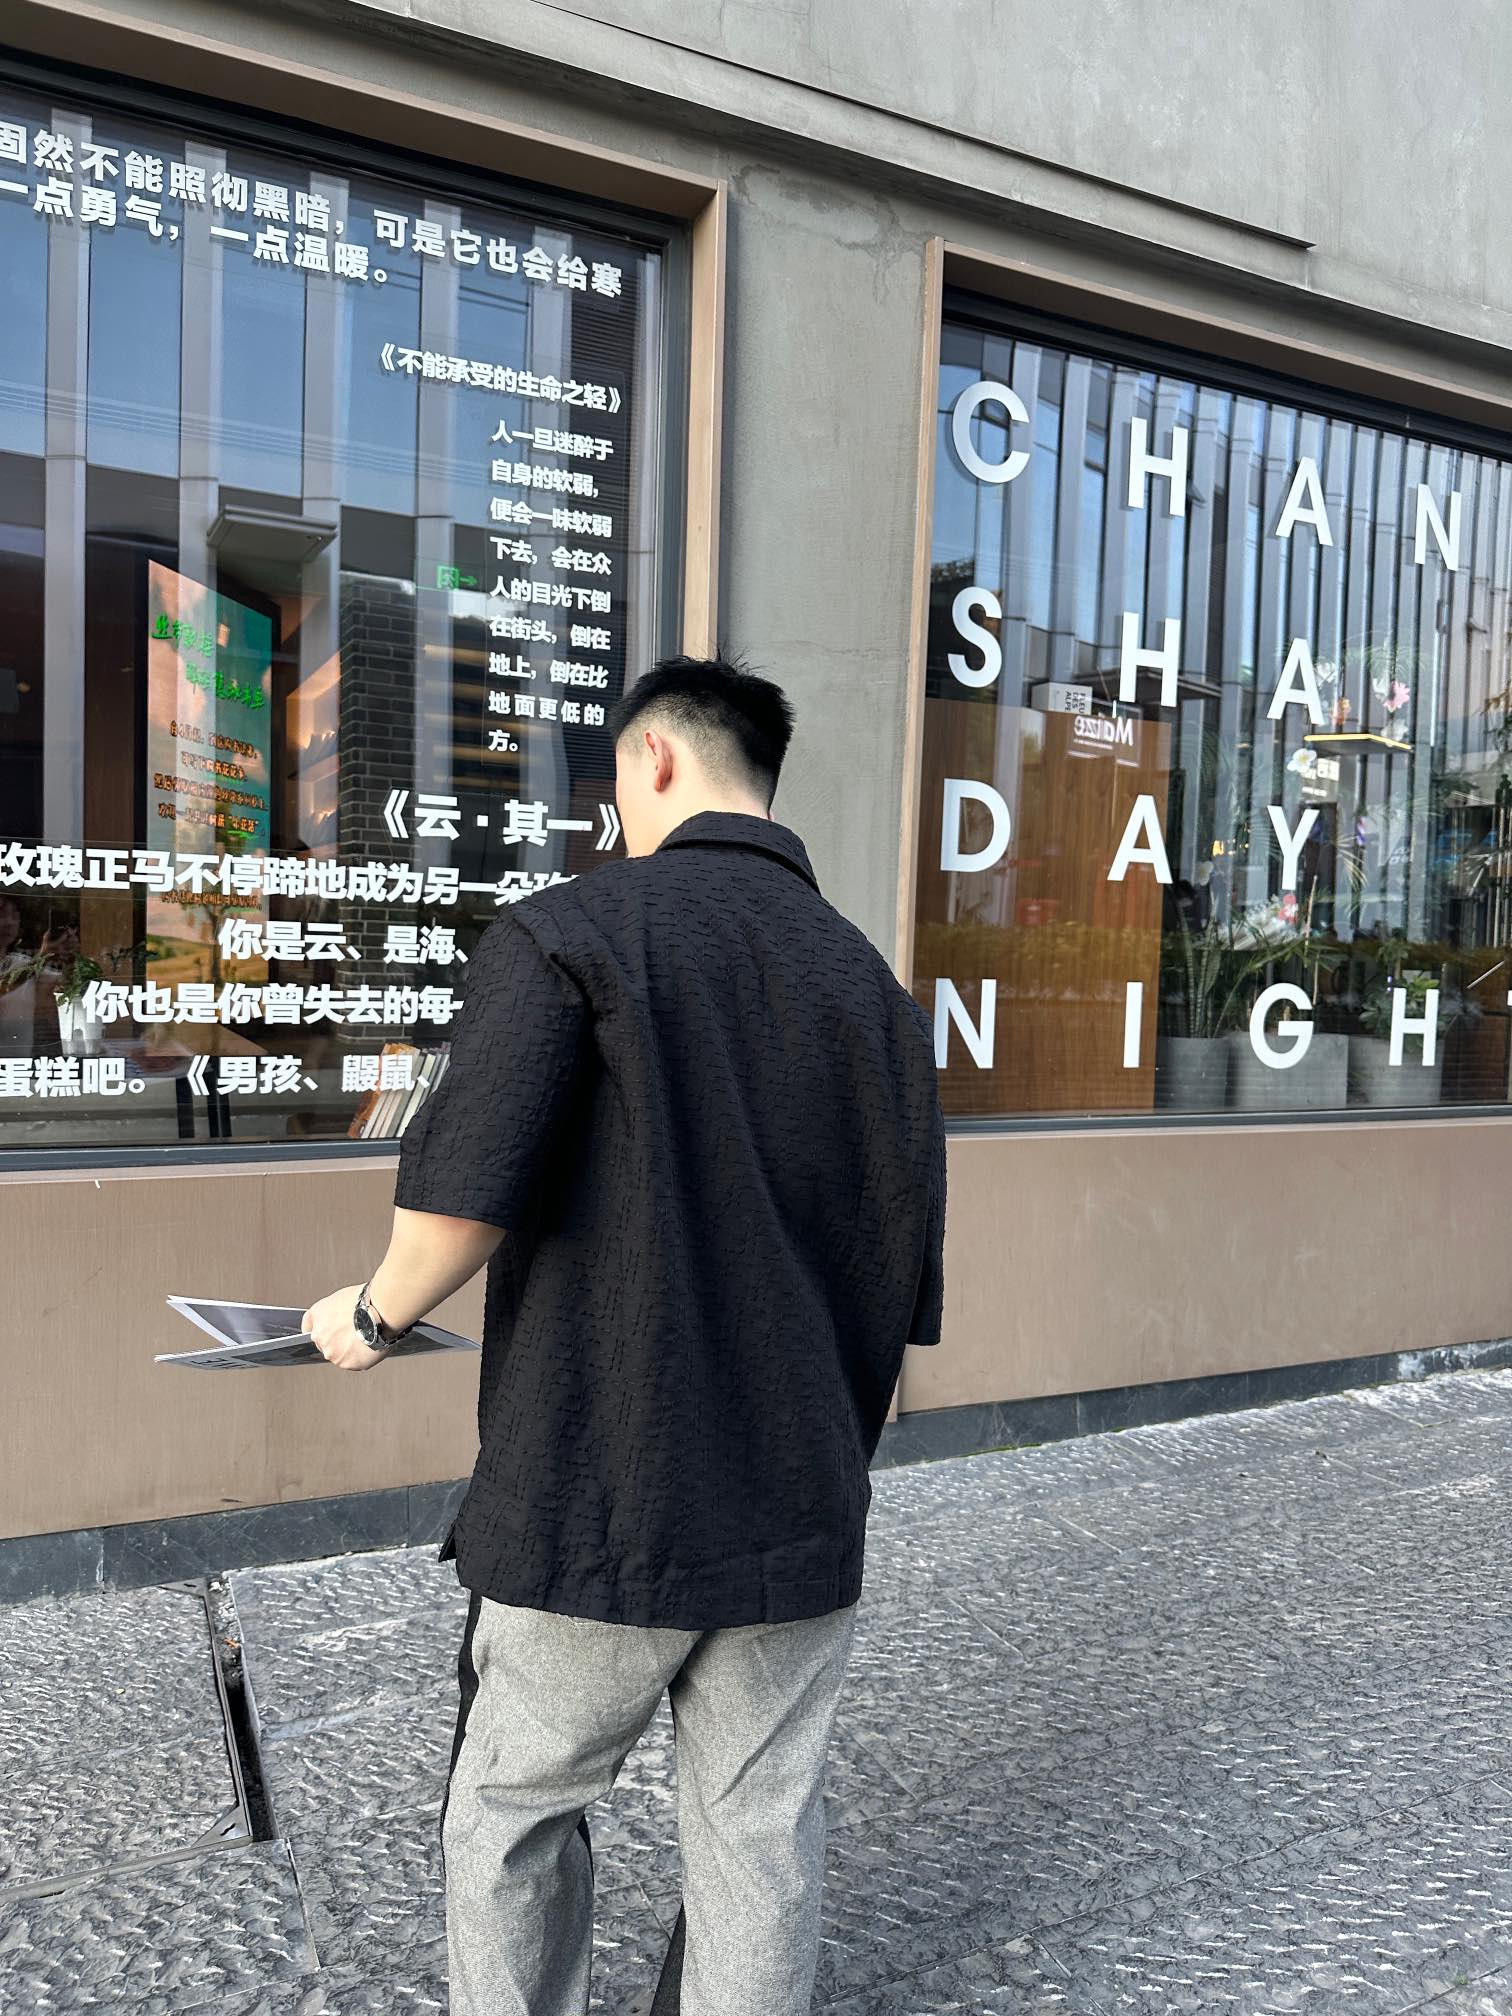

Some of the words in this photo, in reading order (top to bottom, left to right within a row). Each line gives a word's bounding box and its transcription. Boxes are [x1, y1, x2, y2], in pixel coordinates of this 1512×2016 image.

[380, 342, 622, 414] 《不能承受的生命之轻》
[491, 419, 614, 461] 人一旦迷醉于
[491, 459, 599, 499] 自身的软弱，
[490, 497, 613, 538] 便会一味软弱
[490, 575, 611, 613] 人的目光下倒
[488, 690, 605, 726] 地面更低的
[488, 729, 519, 752] 方。
